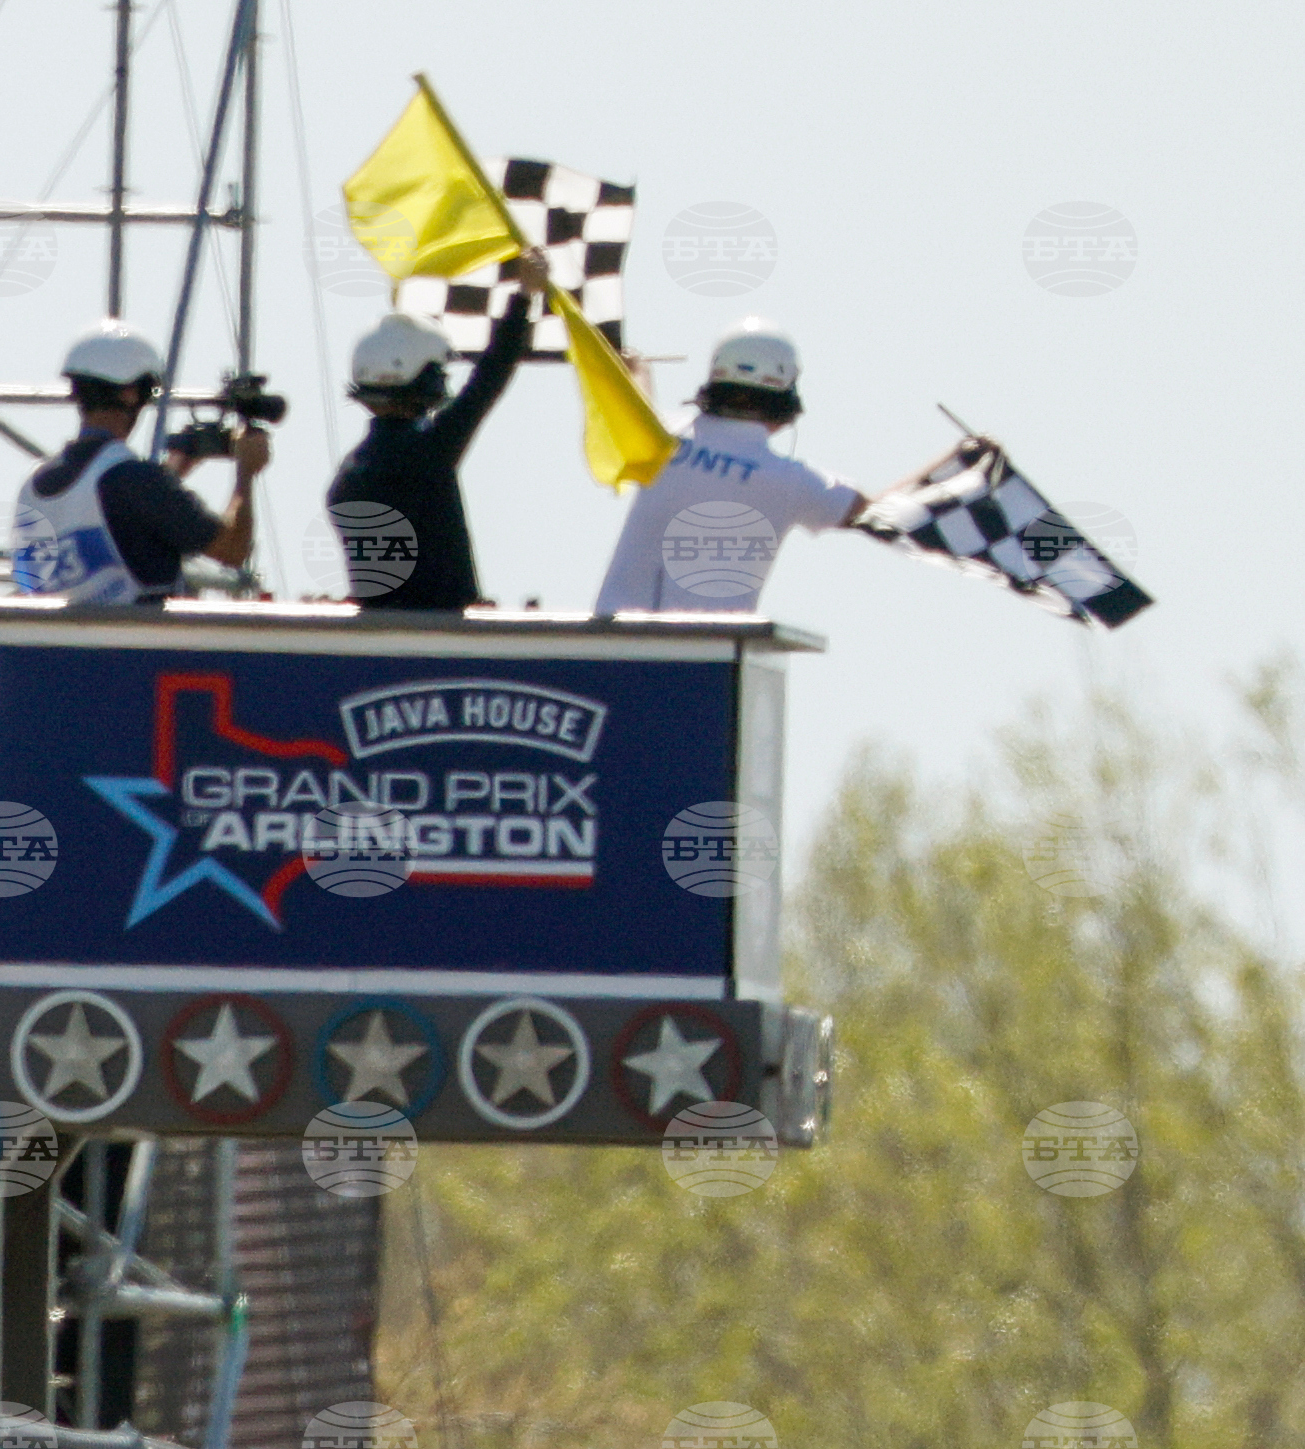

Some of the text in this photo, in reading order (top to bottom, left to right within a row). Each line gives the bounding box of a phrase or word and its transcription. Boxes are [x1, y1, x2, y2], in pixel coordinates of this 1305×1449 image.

[365, 694, 582, 742] JAVA HOUSE
[182, 767, 598, 816] GRAND PRIX
[203, 811, 596, 857] ARLINGTON
